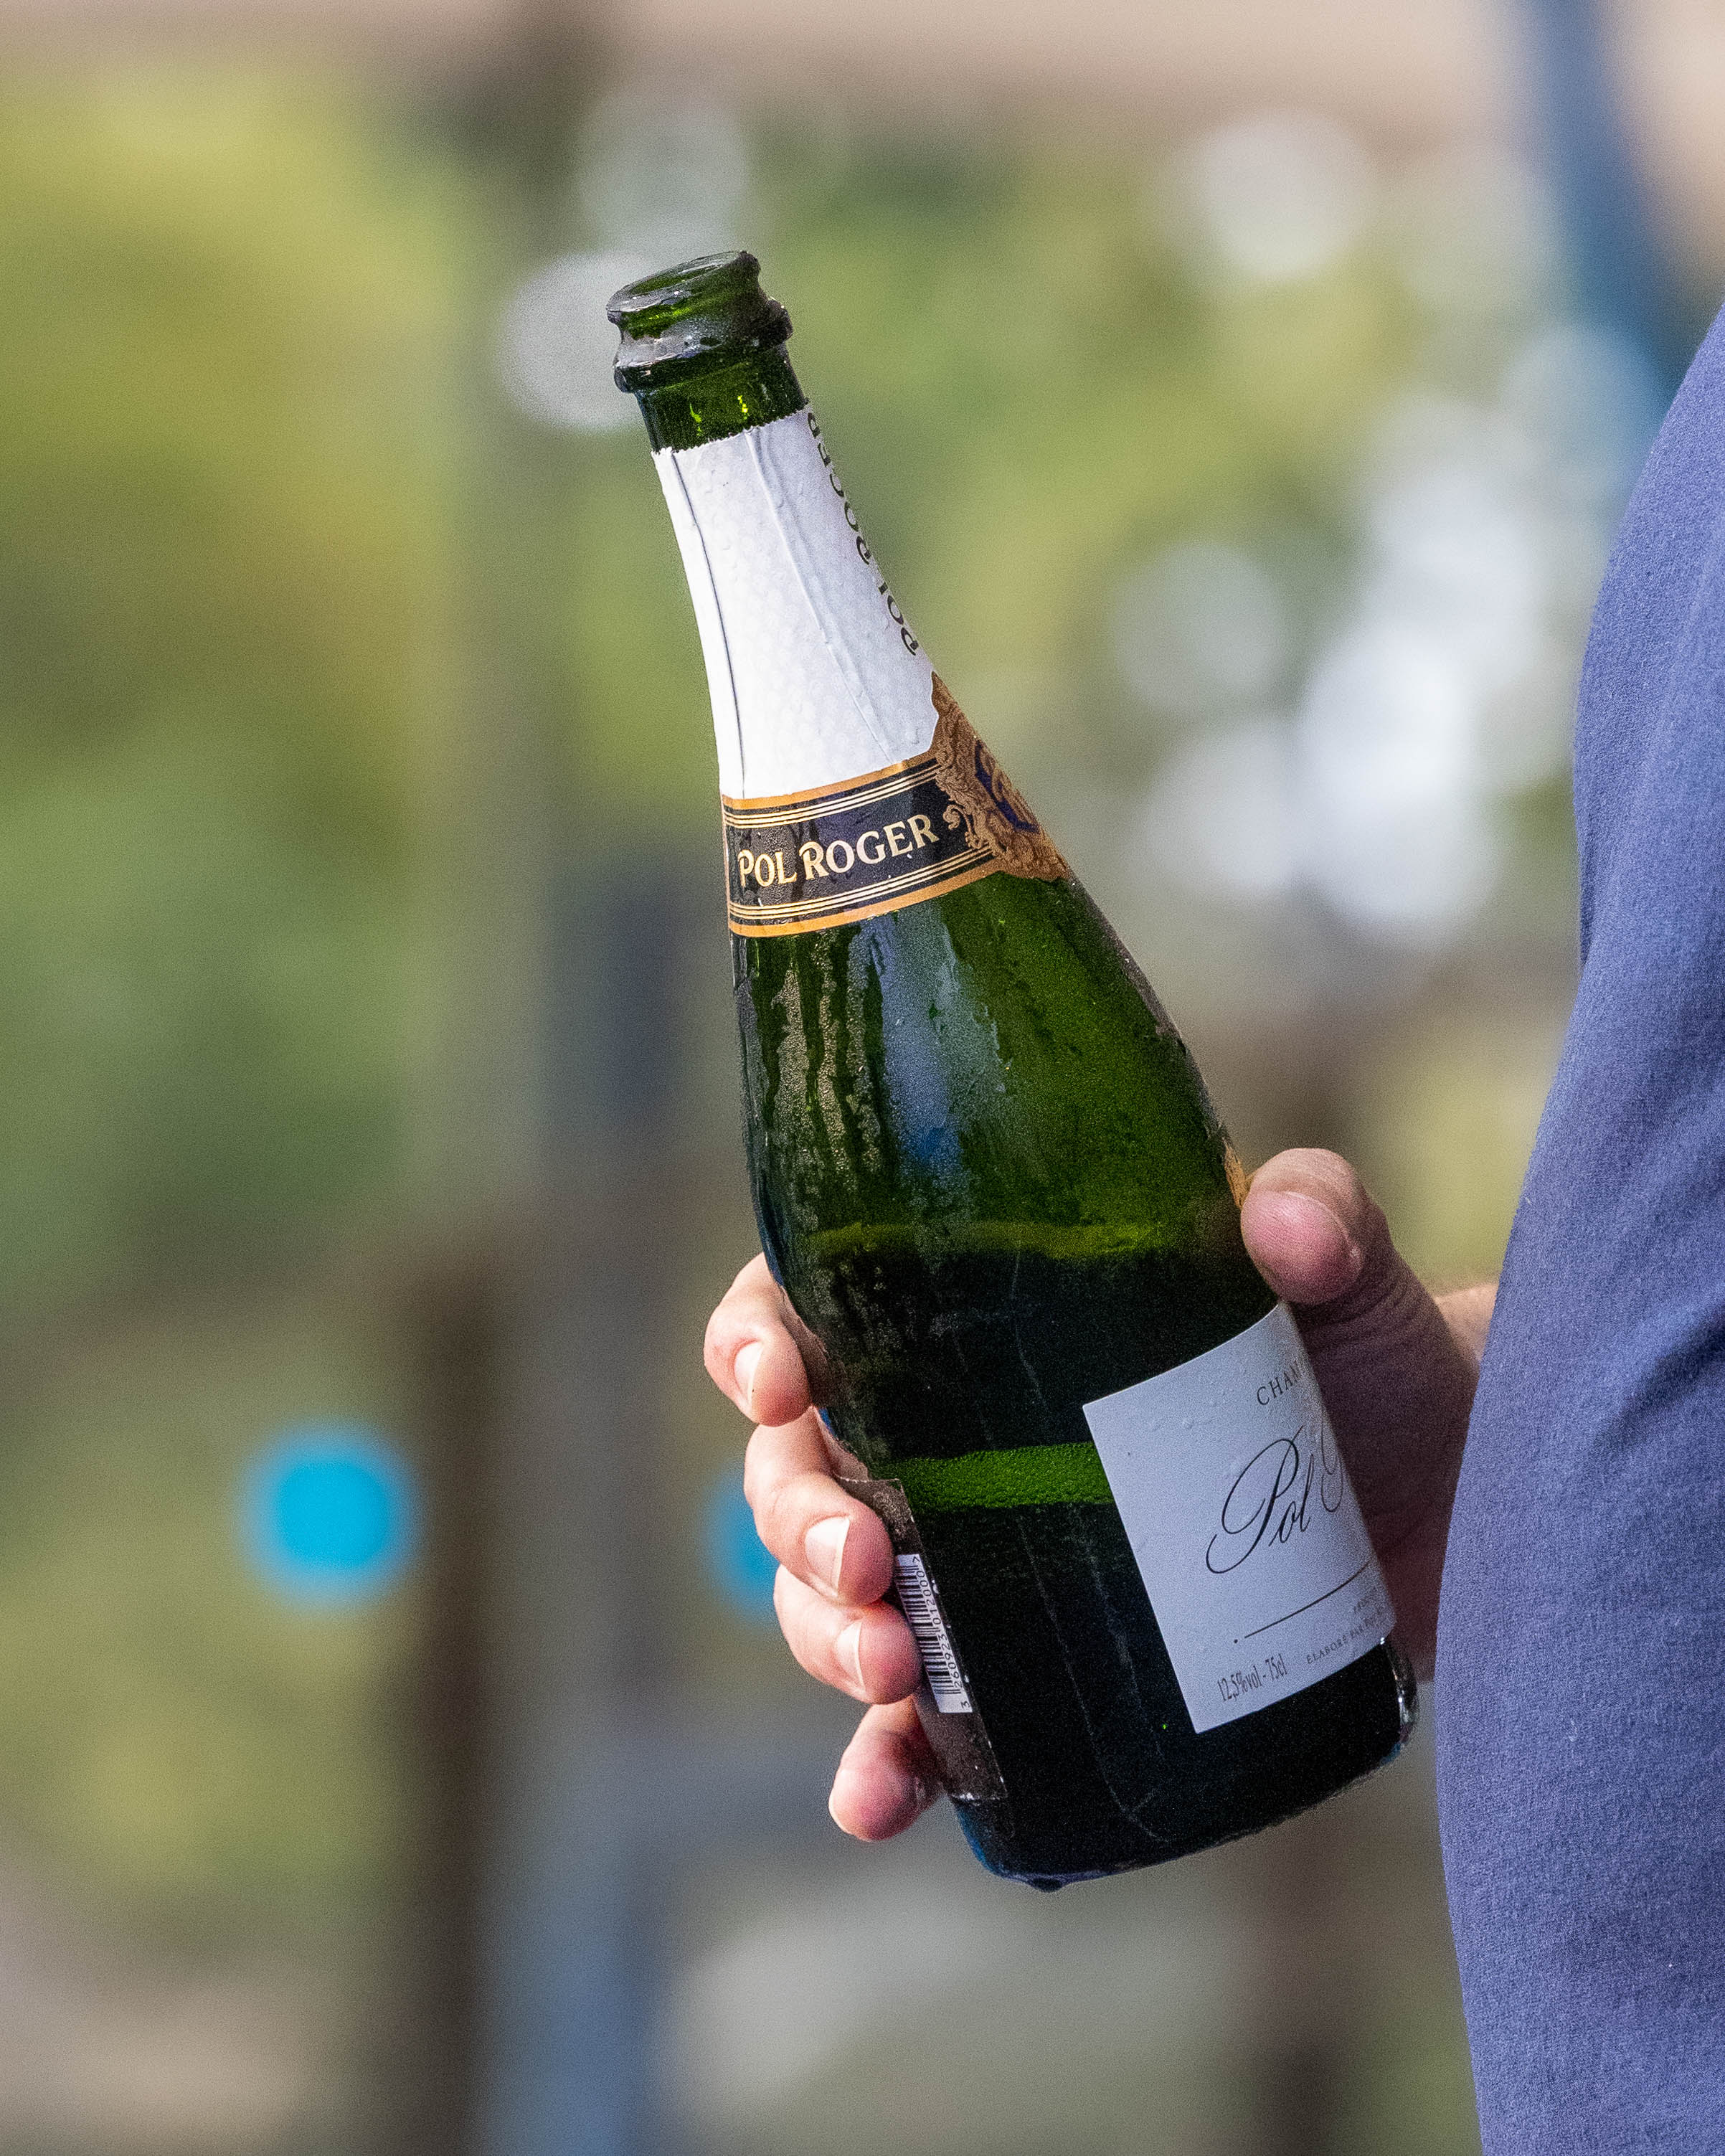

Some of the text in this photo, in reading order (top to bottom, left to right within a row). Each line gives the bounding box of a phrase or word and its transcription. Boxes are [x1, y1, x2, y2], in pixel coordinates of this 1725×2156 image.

[879, 582, 919, 656] POL
[737, 813, 940, 888] POL ROGER
[1206, 1424, 1315, 1574] Pol
[916, 1570, 941, 1625] 012000
[939, 1633, 962, 1688] 260923
[1265, 1653, 1288, 1681] 75cl
[961, 1700, 970, 1709] 3
